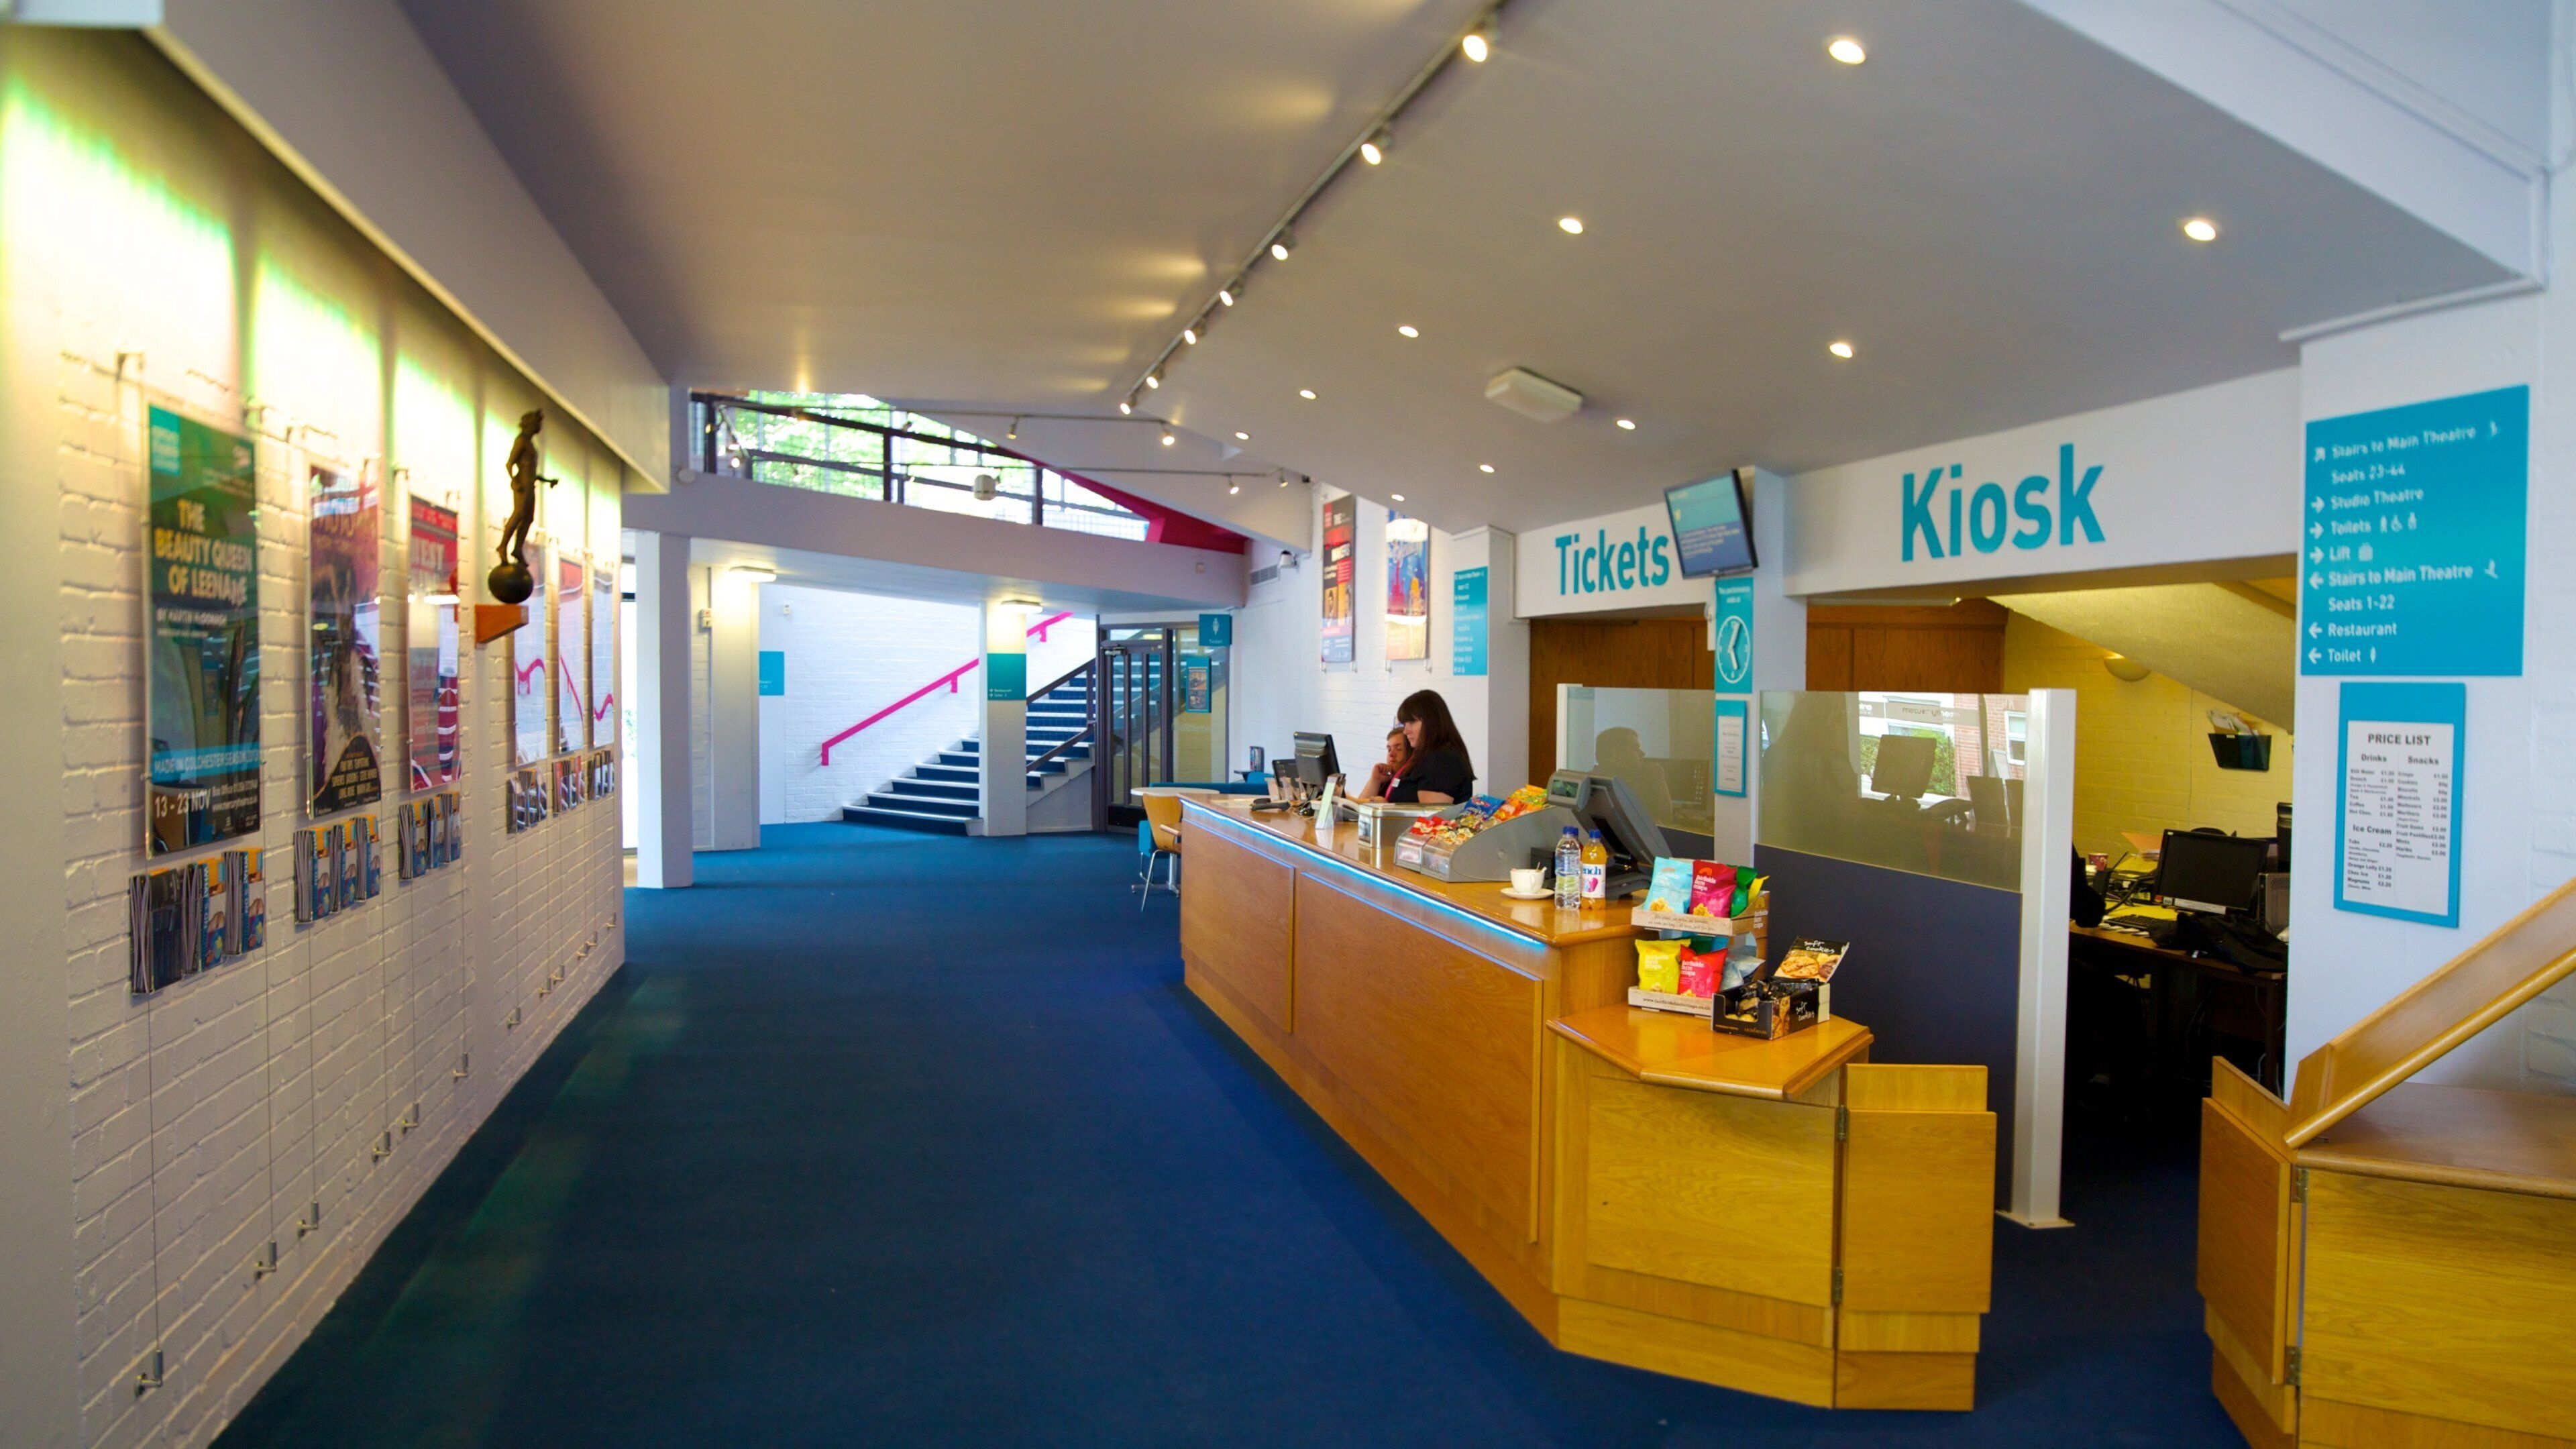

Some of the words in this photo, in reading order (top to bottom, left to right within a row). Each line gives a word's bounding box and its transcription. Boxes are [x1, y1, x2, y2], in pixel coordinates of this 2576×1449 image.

[2332, 444, 2368, 459] Stairs
[2371, 441, 2383, 452] to
[2387, 435, 2419, 449] Main
[2424, 427, 2476, 443] Theatre
[2332, 470, 2365, 484] Seats
[2370, 464, 2405, 480] 23-44
[1902, 443, 2106, 562] Kiosk
[2331, 495, 2370, 510] Studio
[2374, 488, 2424, 503] Theatre
[177, 498, 205, 531] THE
[2331, 520, 2371, 535] Toilets
[155, 528, 211, 566] BEAUTY
[212, 540, 252, 572] QUEEN
[2330, 546, 2351, 561] Lift
[1555, 526, 1669, 596] Tickets
[169, 564, 189, 594] OF
[2328, 570, 2365, 587] Stairs
[2369, 569, 2381, 584] to
[2384, 567, 2416, 583] Main
[2419, 565, 2473, 581] Theatre
[2328, 597, 2363, 612] Seats
[2367, 594, 2395, 610] 1-22
[2328, 623, 2397, 637] Restaurant
[2328, 648, 2361, 662] Toilet
[2368, 733, 2402, 745] PRICE
[2406, 735, 2432, 745] LIST
[2361, 753, 2387, 763] Drinks
[2408, 756, 2439, 765] Snacks
[155, 794, 168, 818] 13
[177, 792, 189, 815] 23
[191, 788, 211, 812] NOV
[2353, 824, 2365, 833] Ice
[2367, 826, 2392, 835] Cream
